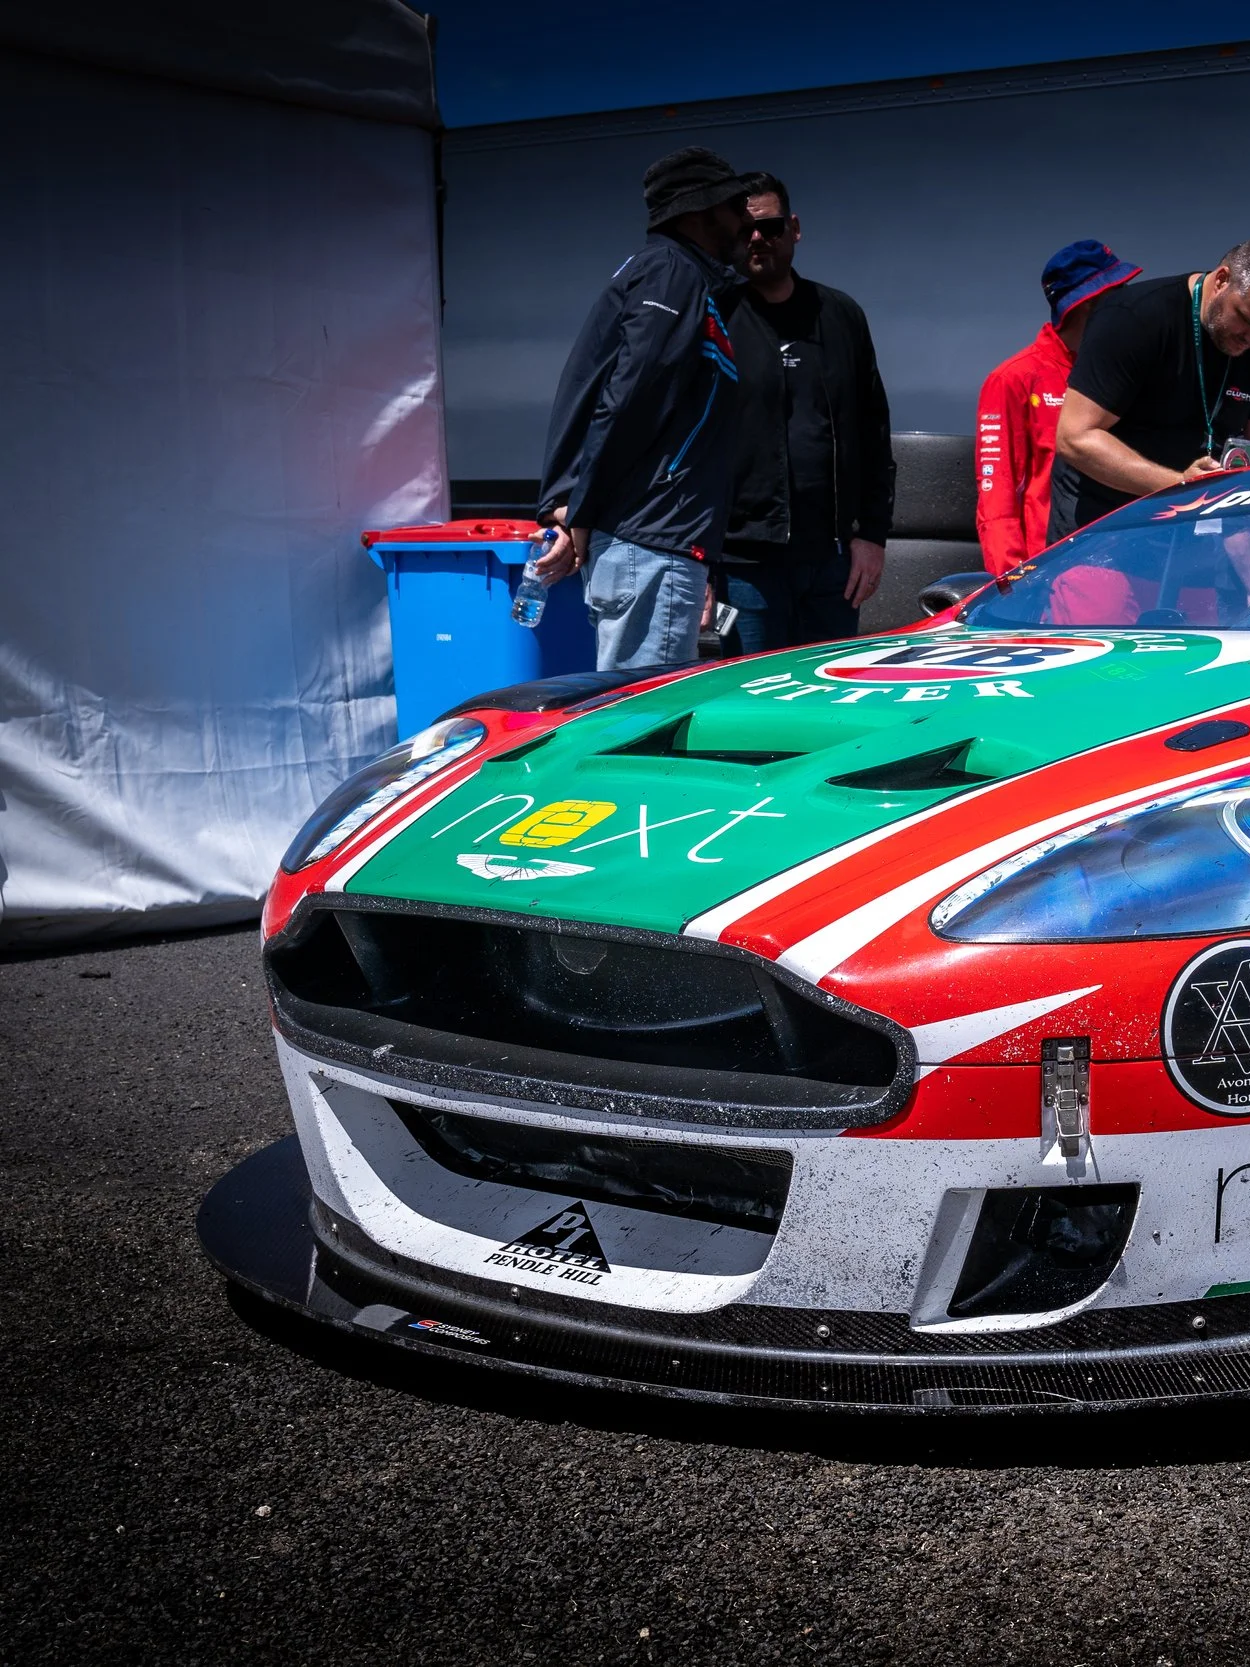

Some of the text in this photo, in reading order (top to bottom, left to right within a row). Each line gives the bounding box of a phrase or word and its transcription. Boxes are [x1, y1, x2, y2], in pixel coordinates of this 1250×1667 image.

[870, 645, 1075, 668] VB
[740, 672, 1035, 704] BITTER
[430, 793, 787, 863] next
[483, 1252, 603, 1286] PENDLE HILL
[504, 1241, 603, 1269] HOTEL
[428, 1327, 491, 1346] COMPOSITES
[438, 1323, 480, 1336] SYDNEY
